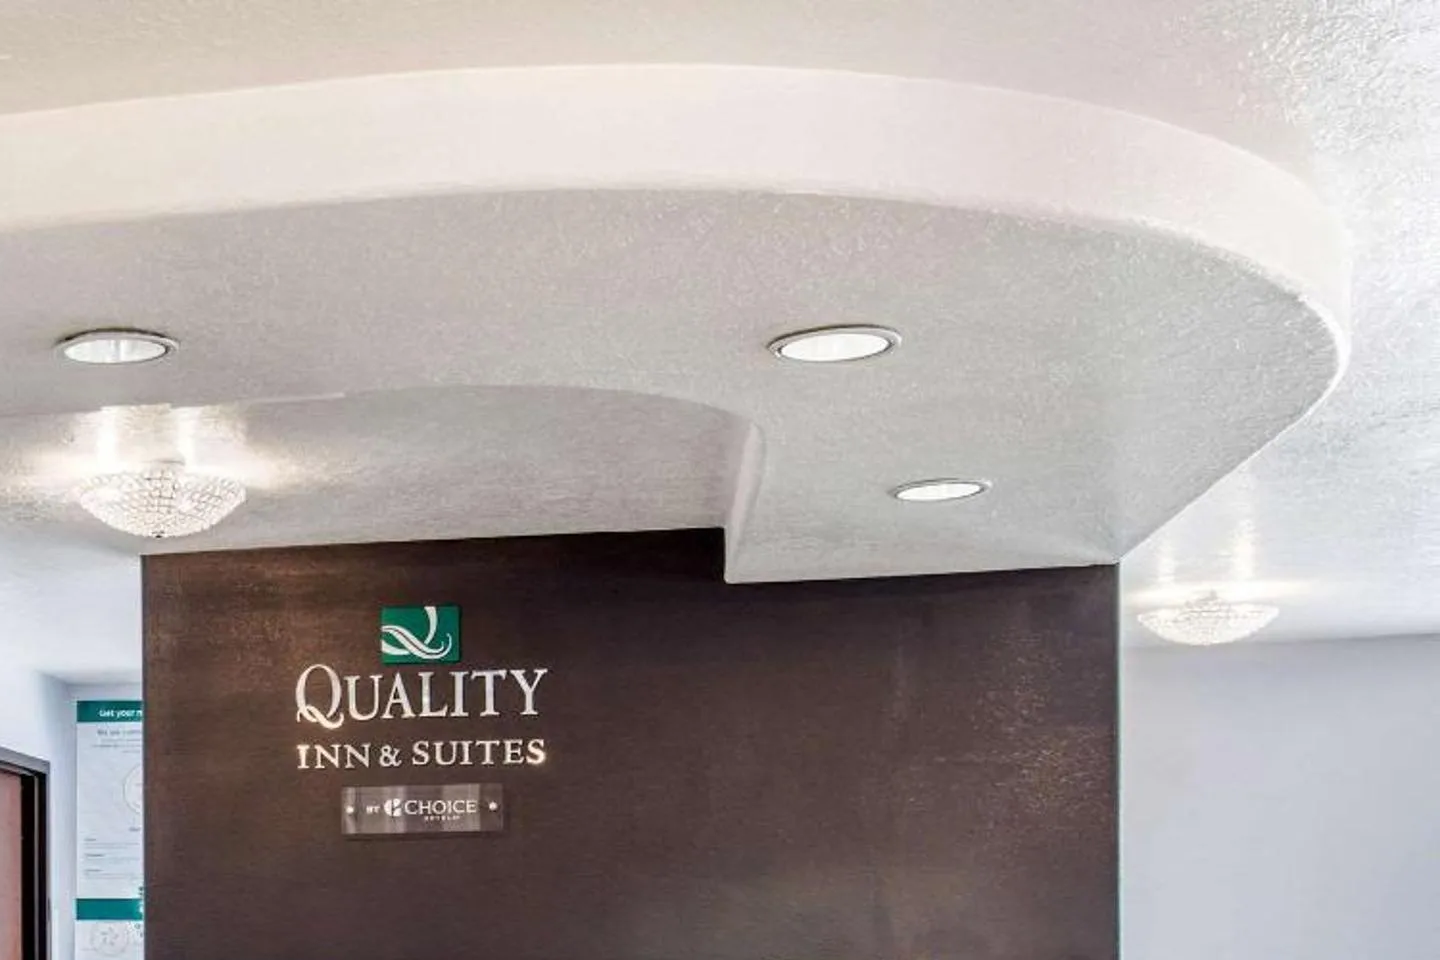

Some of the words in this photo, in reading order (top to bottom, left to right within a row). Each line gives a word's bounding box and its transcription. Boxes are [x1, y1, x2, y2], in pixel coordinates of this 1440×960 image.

[295, 663, 549, 729] QUALITY
[296, 743, 372, 769] INN
[378, 744, 403, 769] &
[411, 738, 547, 766] SUITES
[404, 799, 478, 816] CHOICE
